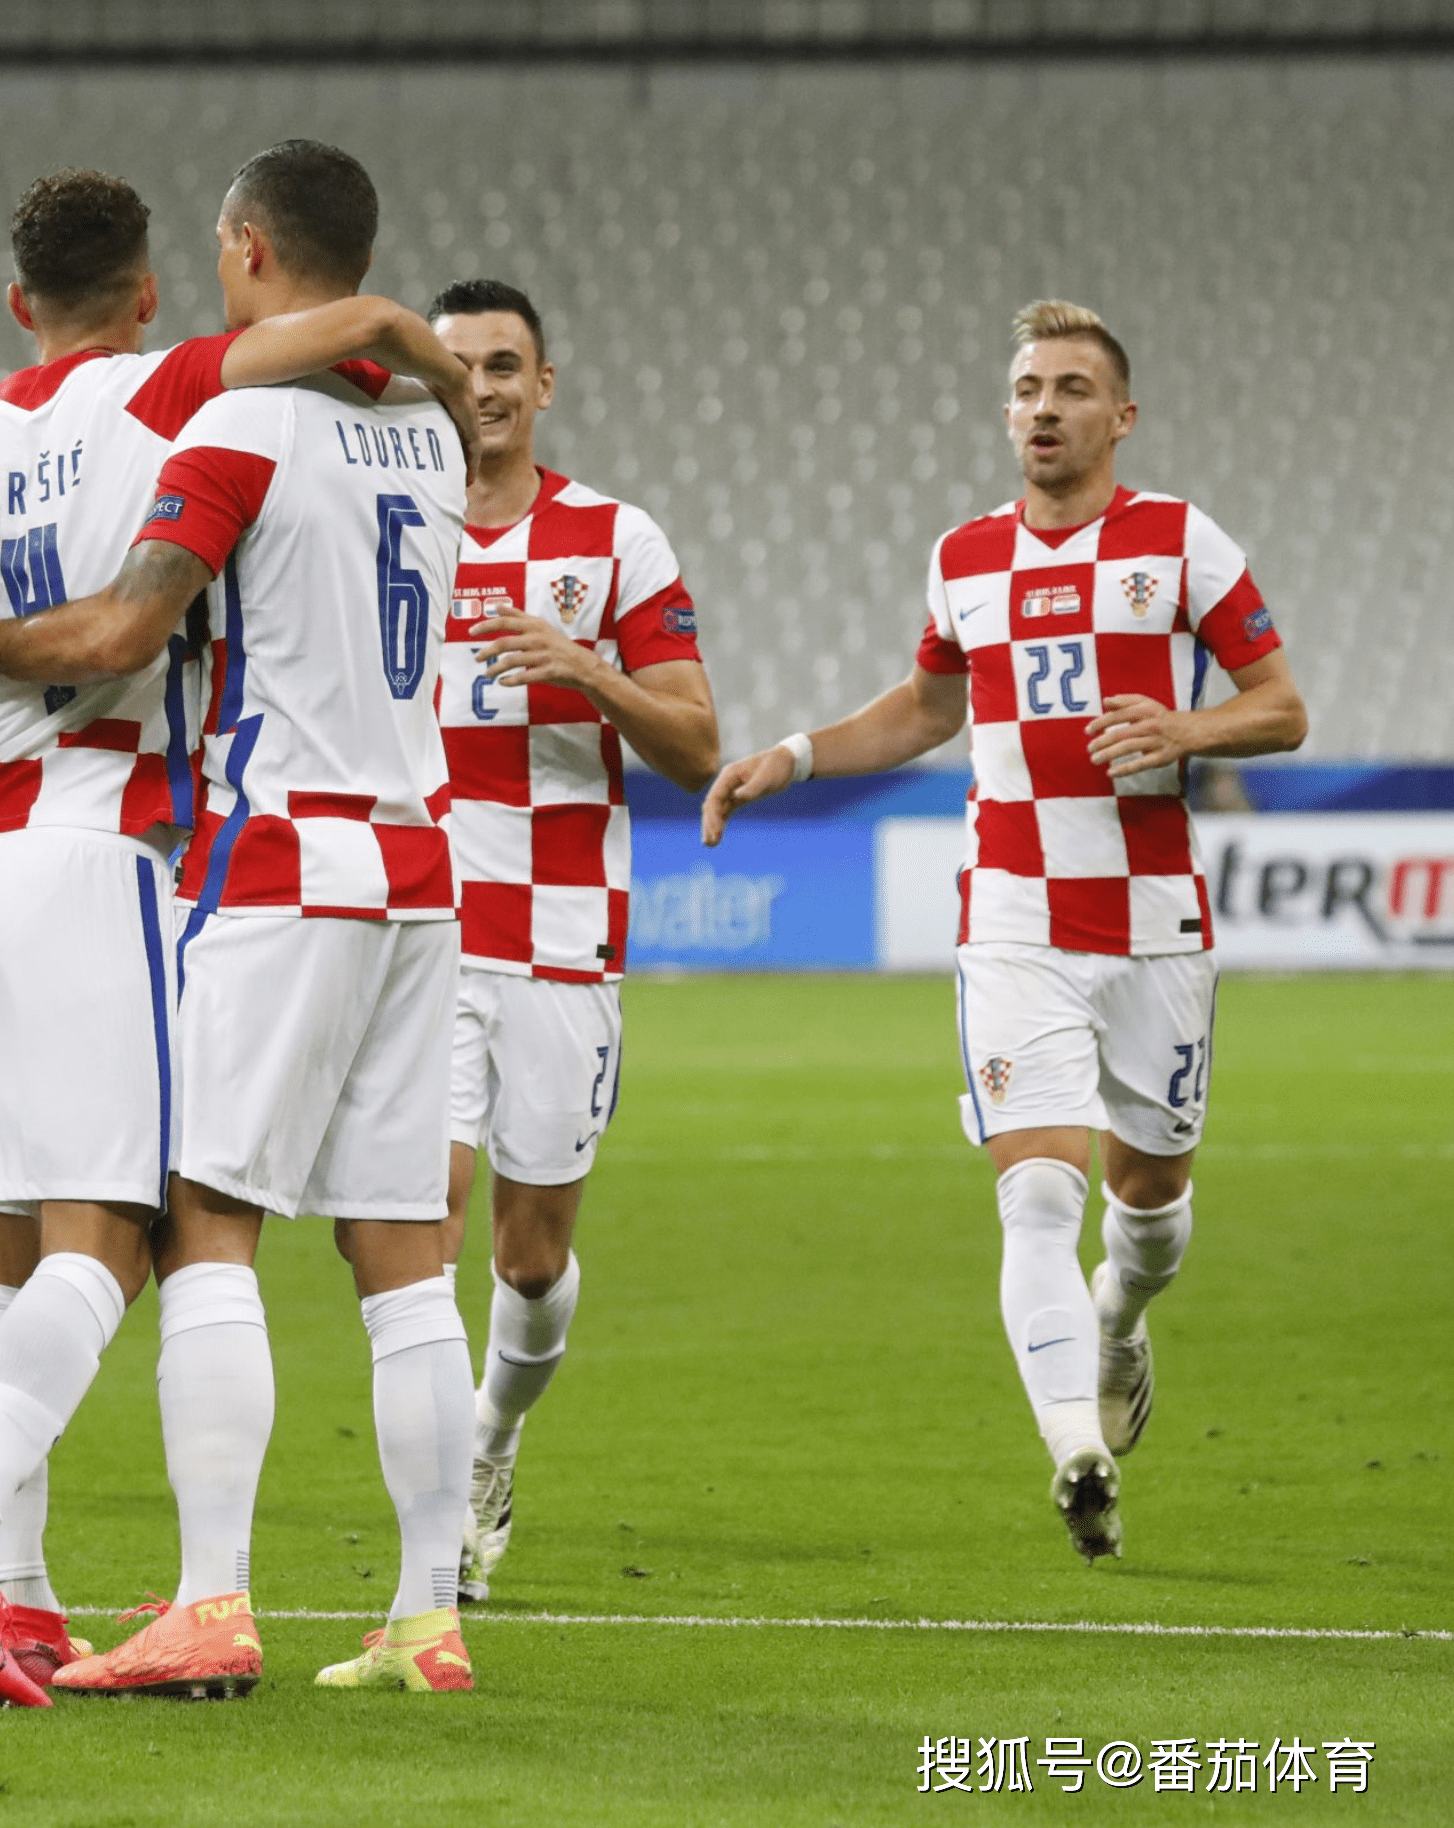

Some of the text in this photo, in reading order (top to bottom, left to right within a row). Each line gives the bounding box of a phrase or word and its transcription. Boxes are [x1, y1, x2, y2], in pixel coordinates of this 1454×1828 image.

[376, 493, 430, 700] 6
[1024, 642, 1089, 714] 22
[590, 1045, 609, 1118] 2
